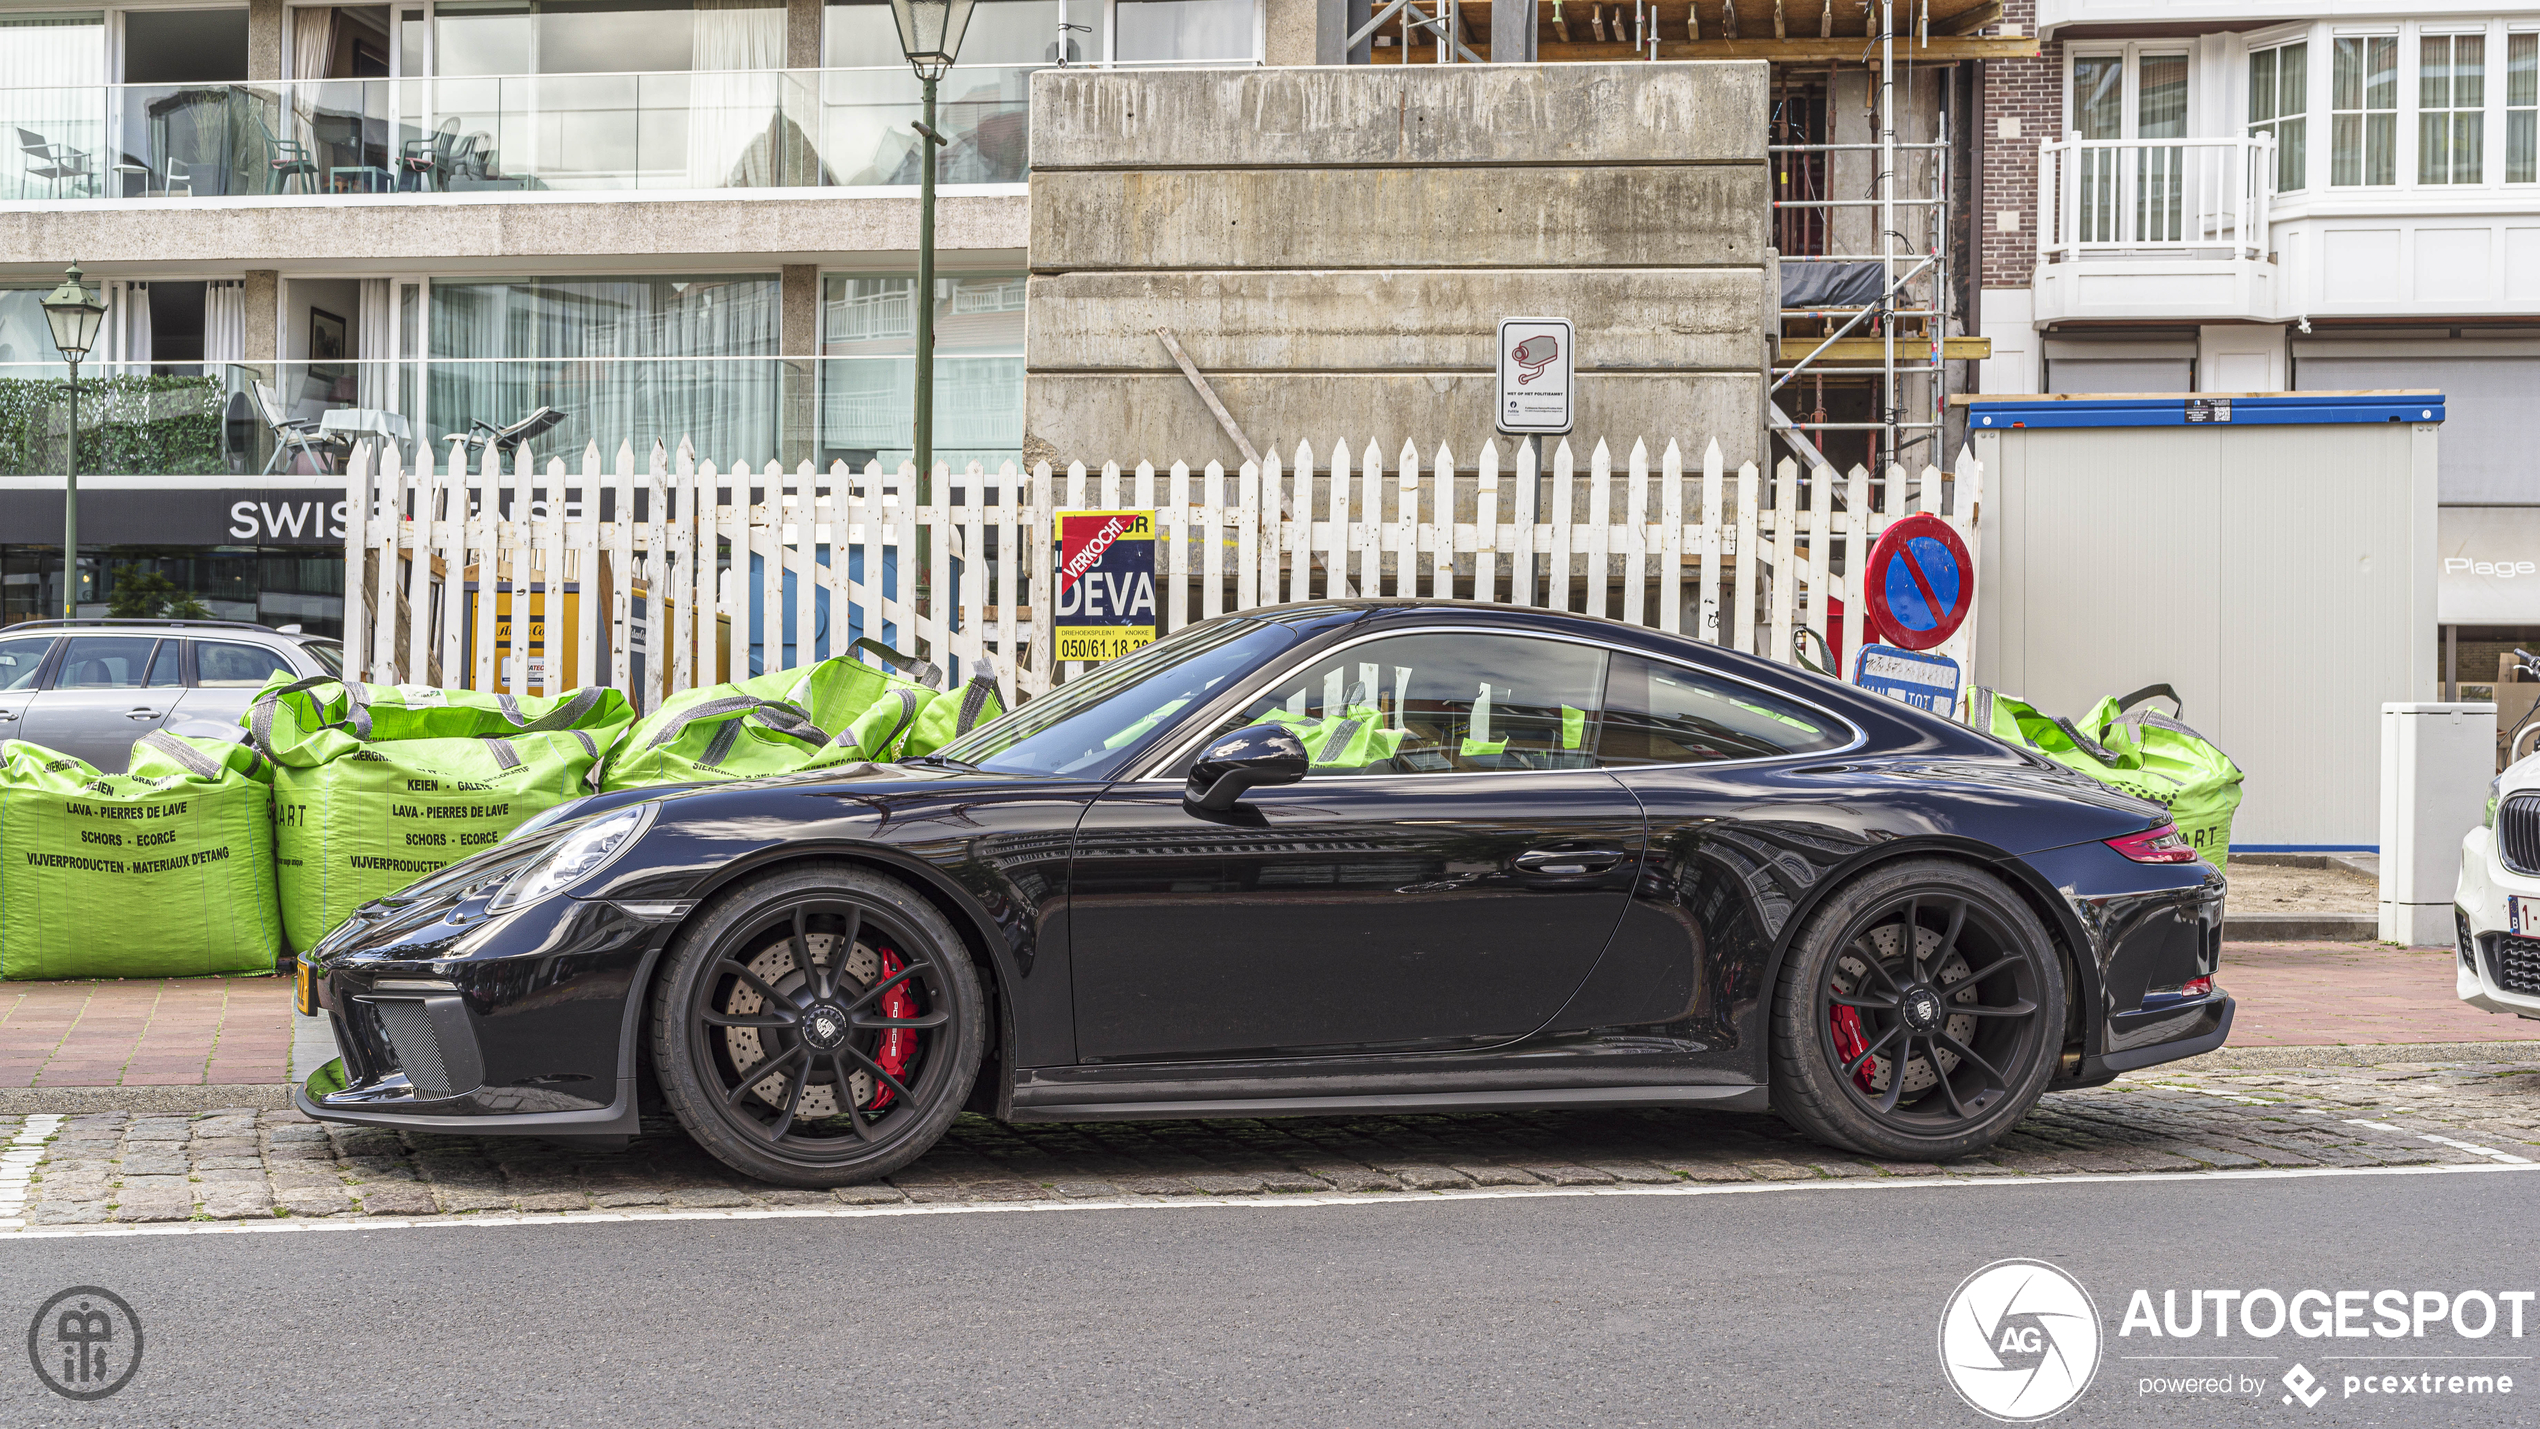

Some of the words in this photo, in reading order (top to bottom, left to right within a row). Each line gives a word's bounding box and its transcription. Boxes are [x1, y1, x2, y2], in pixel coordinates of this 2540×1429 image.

[229, 501, 381, 539] SWIS
[1063, 517, 1124, 578] VERKOCHT
[2443, 557, 2536, 578] Plage
[1055, 572, 1156, 616] DEVA
[407, 779, 439, 791] KEIEN
[66, 802, 92, 817] LAVA
[101, 806, 144, 820] PIERRES
[146, 806, 160, 819] DE
[163, 802, 187, 817] LAVE
[279, 804, 307, 827] ART
[392, 804, 418, 818] LAVA
[426, 806, 468, 818] PIERRES
[471, 806, 484, 817] DE
[486, 803, 509, 817] LAVE
[81, 830, 122, 846] SCHORS
[136, 830, 176, 846] ECORCE
[405, 833, 446, 846] SCHORS
[460, 831, 498, 845] ECORCE
[27, 852, 124, 873] VIJVERPRODUCTEN
[133, 855, 190, 873] MATERIAUX
[192, 846, 229, 865] D'ETANG
[2512, 917, 2518, 929] B
